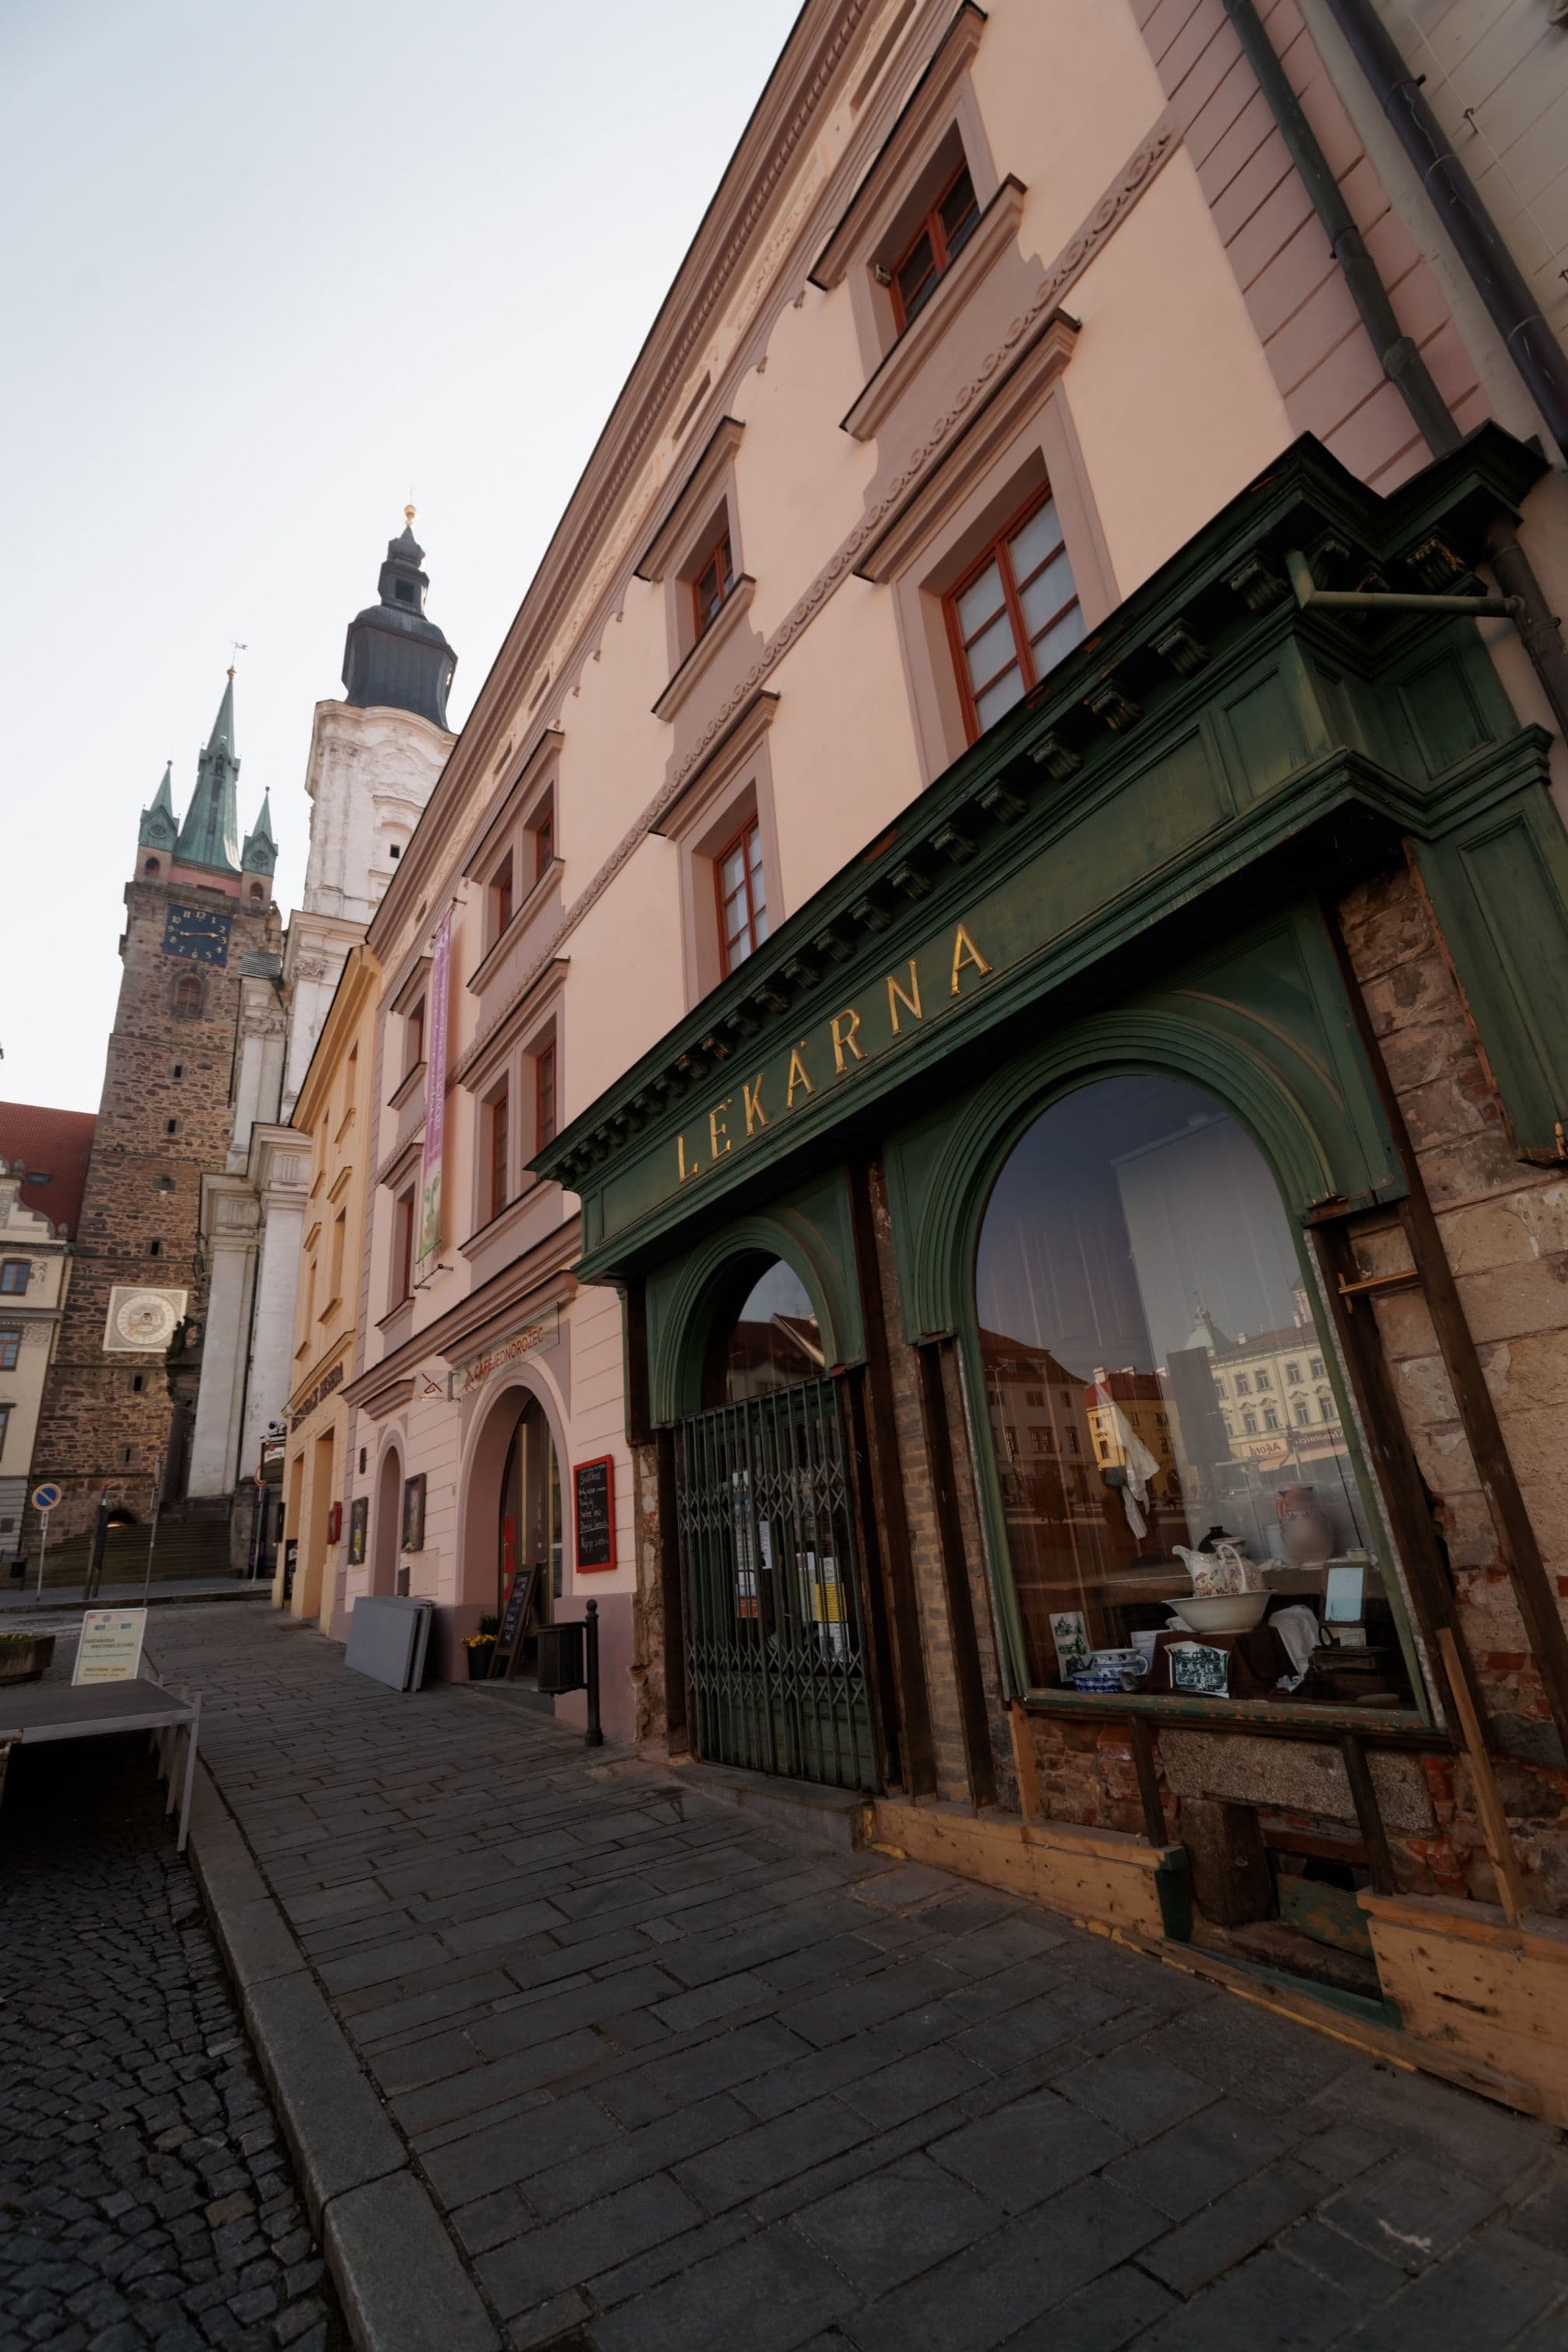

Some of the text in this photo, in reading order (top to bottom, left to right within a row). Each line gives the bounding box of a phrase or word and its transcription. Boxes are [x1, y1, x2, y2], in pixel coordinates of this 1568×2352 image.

[183, 910, 191, 919] 11
[196, 911, 206, 919] 12
[172, 915, 181, 924] 10
